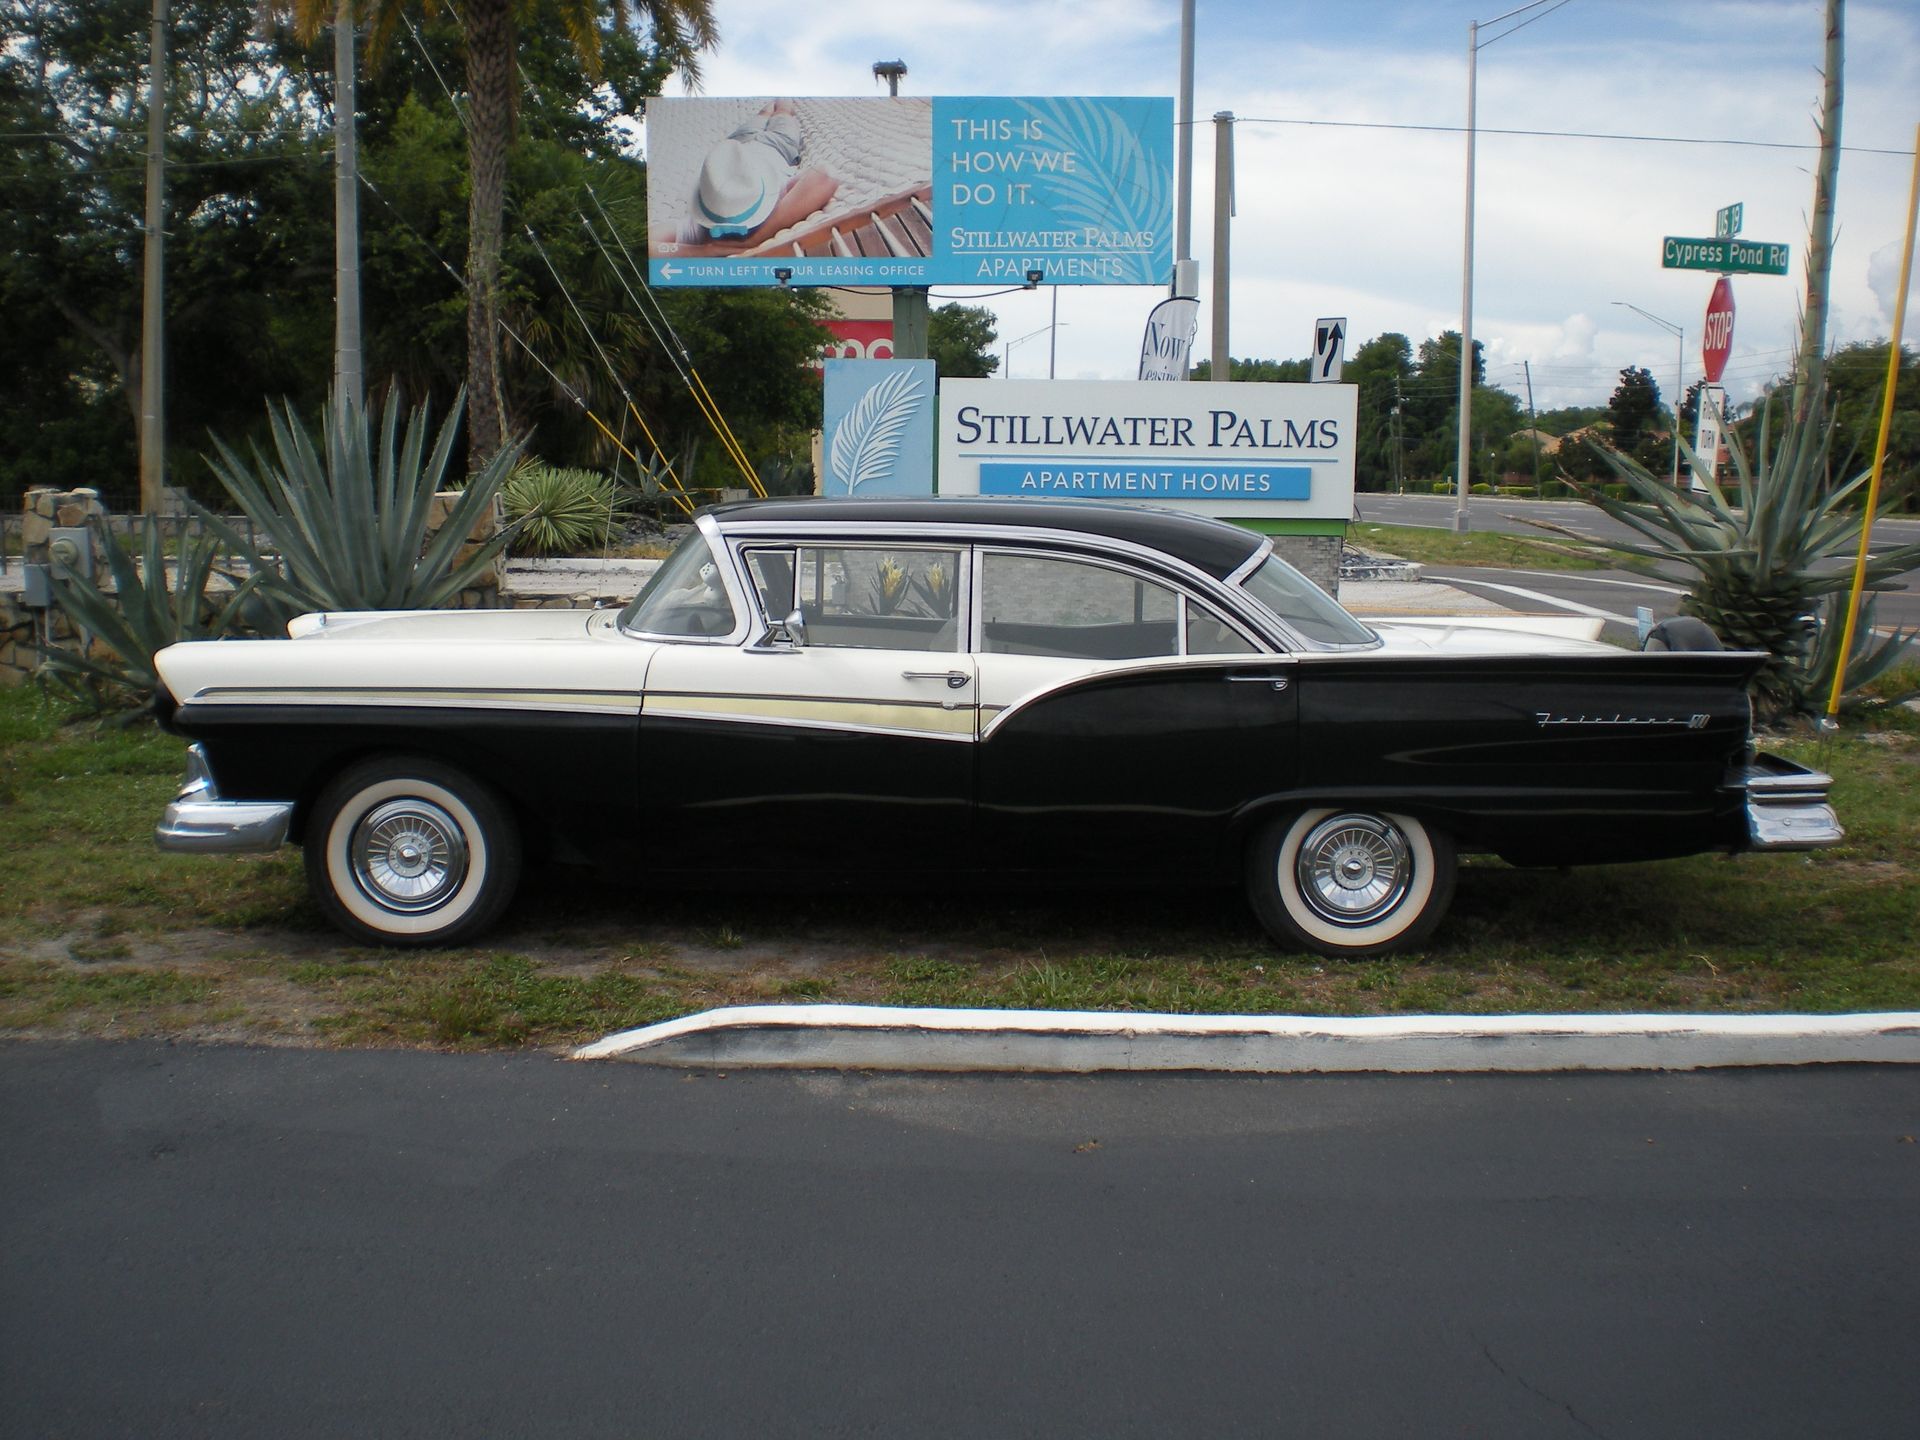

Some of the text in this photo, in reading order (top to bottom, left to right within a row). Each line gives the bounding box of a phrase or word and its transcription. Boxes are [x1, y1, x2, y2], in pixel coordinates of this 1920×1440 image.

[951, 119, 1043, 140] THIS IS
[952, 151, 1076, 173] HOW WE
[952, 183, 1035, 205] DO IT.
[1718, 205, 1740, 236] US 19
[951, 227, 1154, 248] STILLWATER PALMS
[1665, 239, 1788, 267] Cypress Pond Rd
[688, 265, 724, 276] TURN
[729, 265, 759, 276] LEFT
[820, 265, 873, 277] LEASING
[879, 264, 925, 276] OFFICE
[976, 258, 1123, 277] APARTMENTS
[1705, 311, 1733, 350] STOP
[956, 406, 1339, 449] STILLWATER PALMS
[1020, 471, 1272, 492] APARTMENT HOMES
